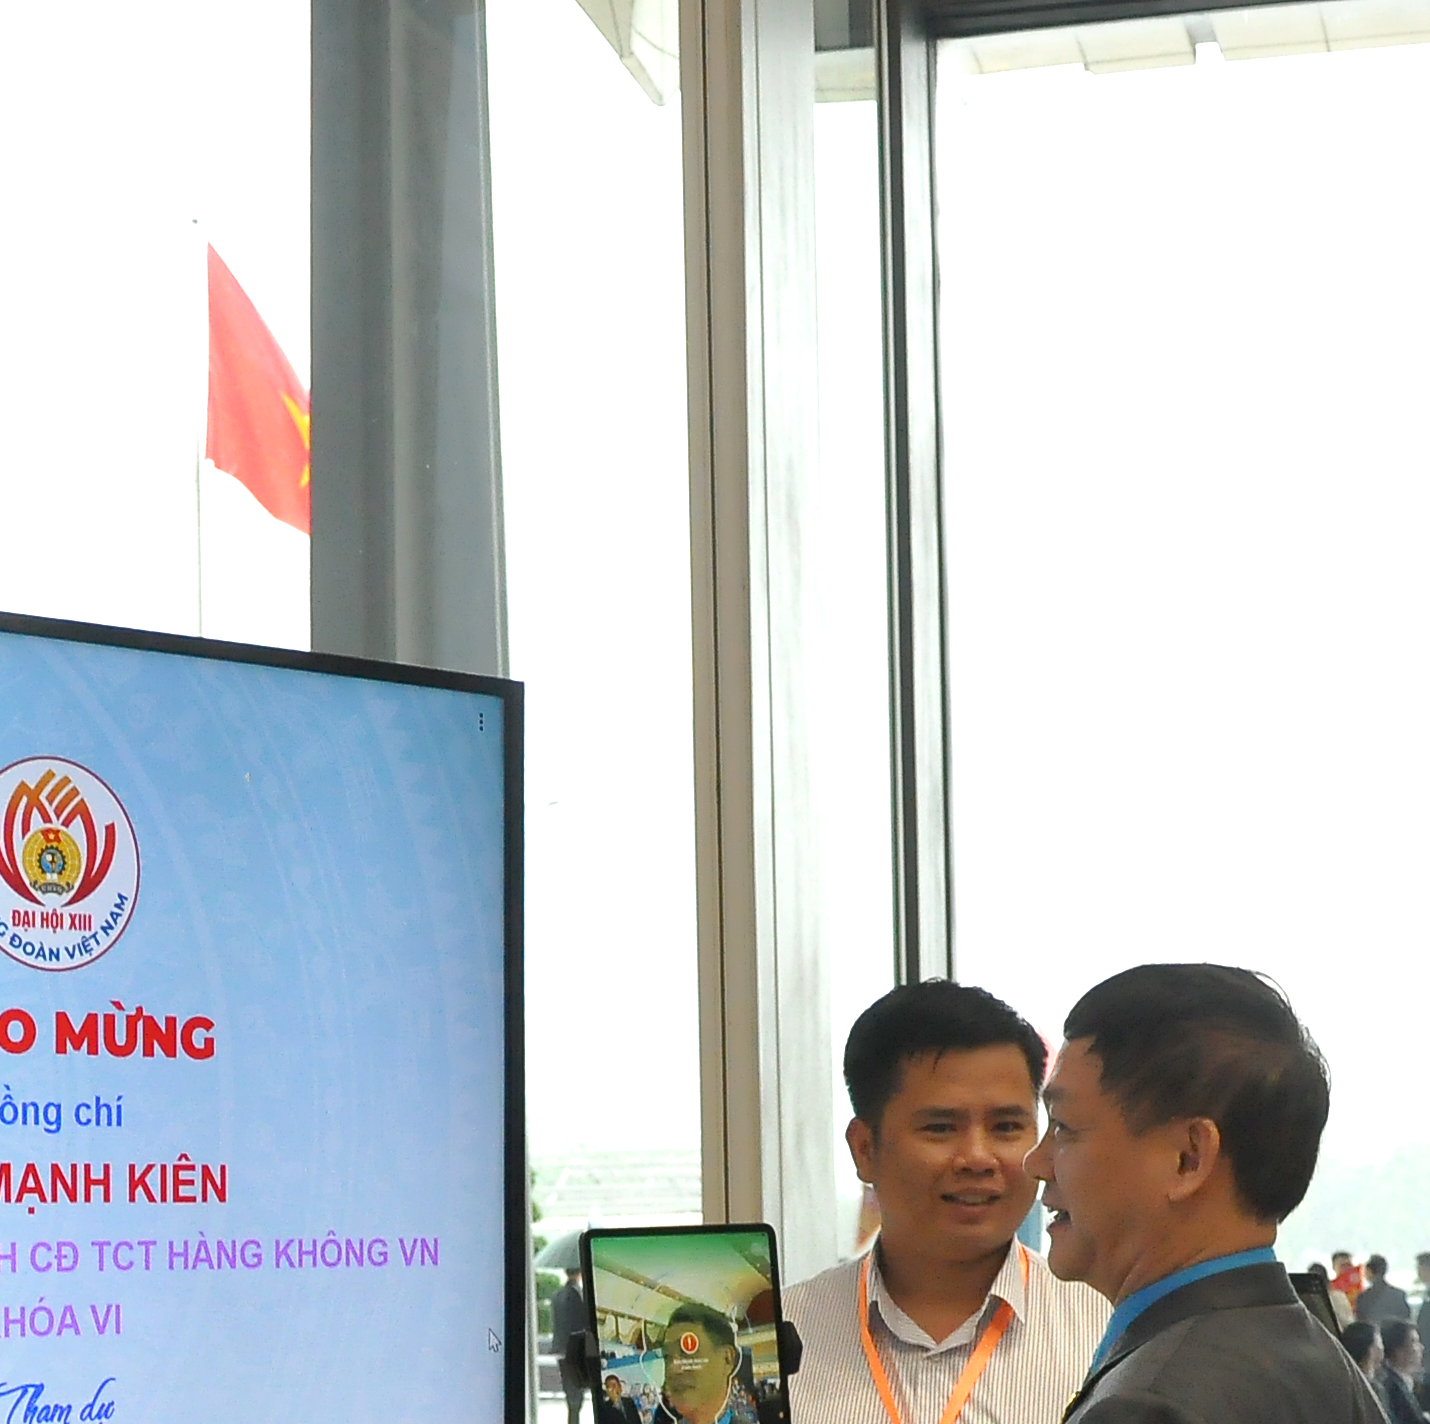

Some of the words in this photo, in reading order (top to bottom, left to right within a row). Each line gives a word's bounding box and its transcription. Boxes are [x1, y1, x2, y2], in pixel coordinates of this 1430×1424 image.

[8, 932, 61, 962] ĐOÀN
[64, 931, 101, 961] VIỆT
[100, 892, 129, 937] NAM
[11, 908, 36, 932] ĐẠI
[40, 908, 64, 934] HỘI
[69, 912, 92, 932] XIII
[55, 1000, 216, 1060] MỪNG
[74, 1094, 124, 1127] chí
[128, 1152, 227, 1204] KIÊN
[30, 1240, 79, 1273] CĐ
[91, 1240, 157, 1272] TCT
[168, 1231, 263, 1270] HÀNG
[274, 1229, 389, 1269] KHÔNG
[398, 1237, 440, 1267] VN
[90, 1303, 122, 1335] VI
